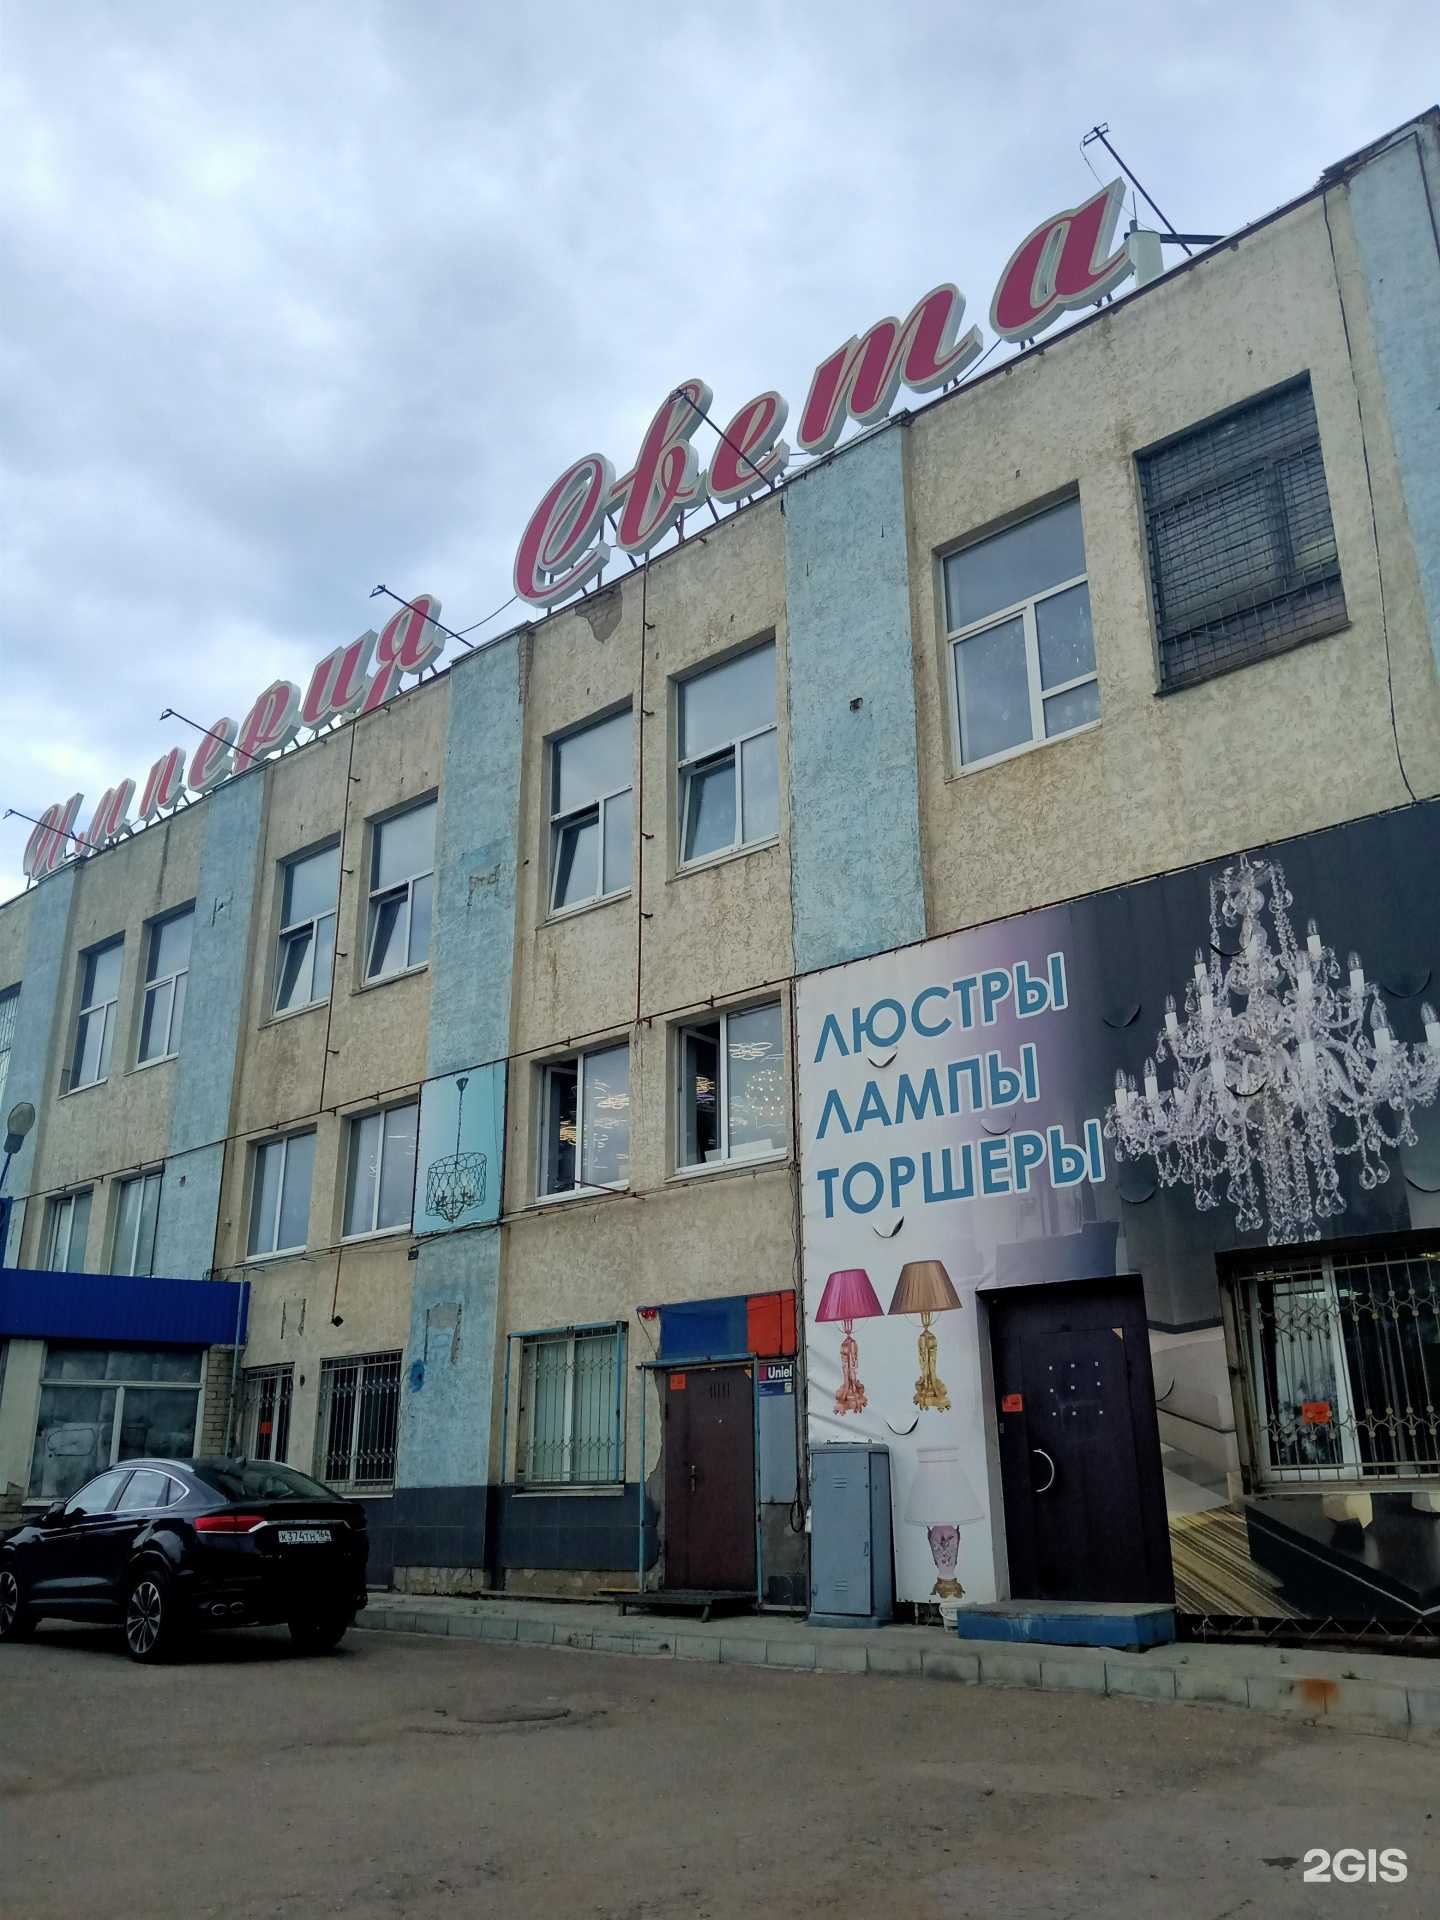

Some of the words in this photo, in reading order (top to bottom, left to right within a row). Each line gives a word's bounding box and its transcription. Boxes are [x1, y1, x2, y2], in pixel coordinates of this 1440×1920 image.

[23, 594, 446, 881] Империя
[513, 177, 1136, 608] Света
[814, 952, 1069, 1063] ЛЮСТРЫ
[816, 1043, 1039, 1140] ЛАМПЫ
[817, 1119, 1105, 1219] ТОРШЕРЫ
[768, 1364, 792, 1379] Uniel
